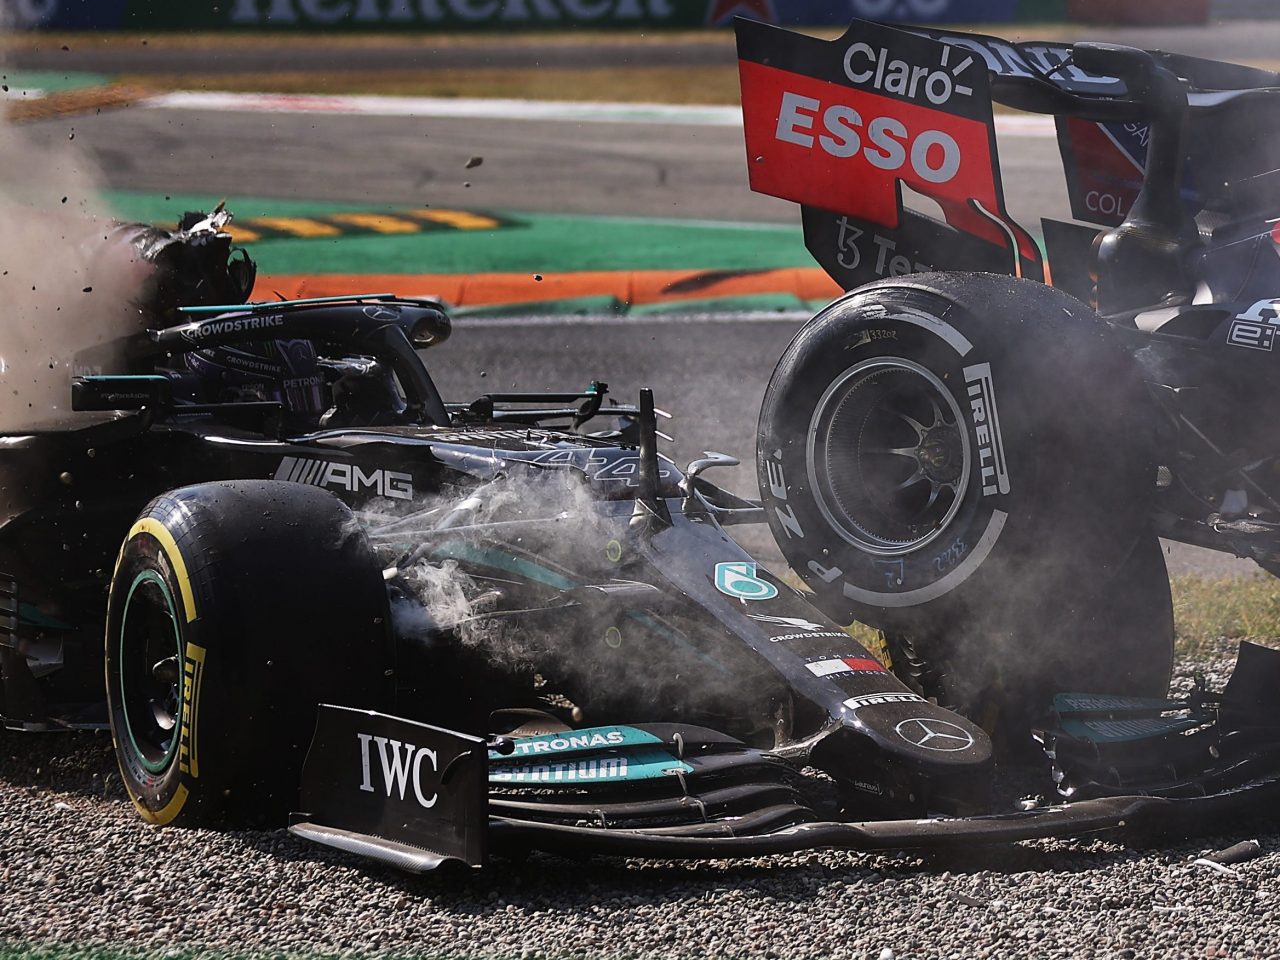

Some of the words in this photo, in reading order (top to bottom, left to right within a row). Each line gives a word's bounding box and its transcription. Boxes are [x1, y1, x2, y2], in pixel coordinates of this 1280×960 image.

[843, 42, 952, 105] Claro
[775, 91, 961, 183] ESSO
[187, 315, 285, 339] CROWDSTRIKE
[226, 355, 282, 374] CROWDSTRIKE
[963, 362, 1011, 497] PIRELLI
[325, 463, 413, 501] AMG
[769, 632, 851, 643] CROWDSTRIKE
[179, 641, 206, 778] PIRELLI
[513, 731, 624, 755] TRONAS
[357, 732, 438, 809] IWC
